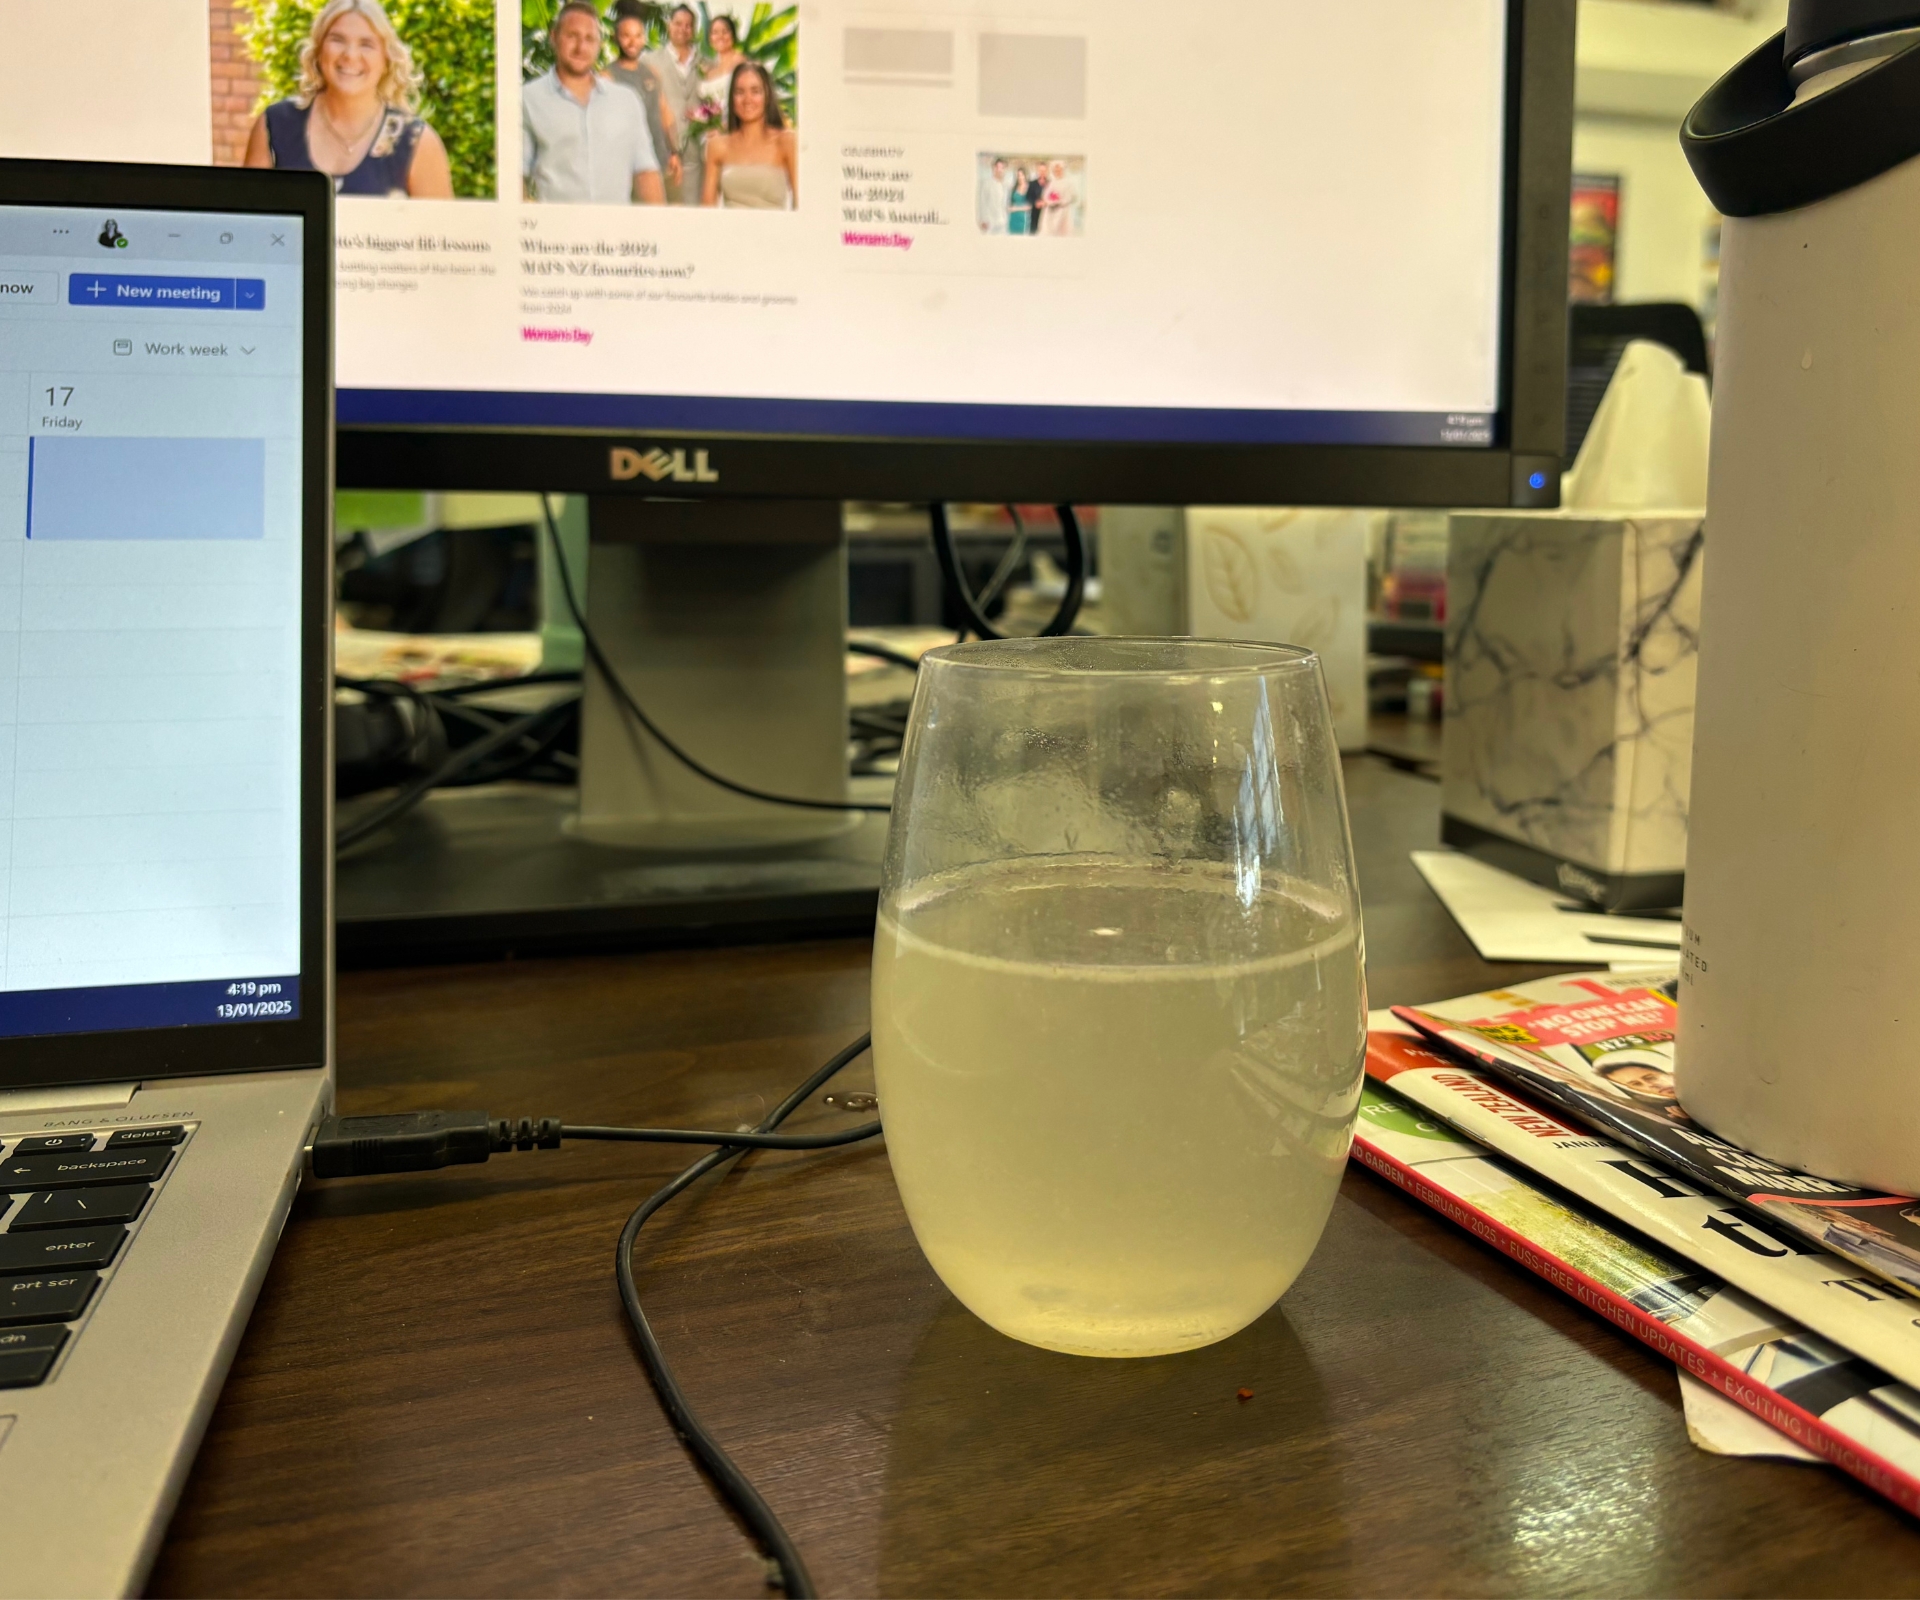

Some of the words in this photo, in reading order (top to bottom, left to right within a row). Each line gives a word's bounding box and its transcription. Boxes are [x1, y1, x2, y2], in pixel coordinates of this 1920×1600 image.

[0, 283, 34, 295] now
[117, 285, 152, 298] New
[157, 286, 221, 303] meeting
[145, 342, 184, 355] Work
[192, 344, 228, 356] week
[46, 386, 75, 407] 17
[42, 416, 82, 430] Friday
[609, 447, 718, 482] DELL
[226, 982, 255, 996] 4:19
[259, 982, 281, 997] pm
[216, 1000, 292, 1018] 13/01/2025
[1570, 1004, 1619, 1021] ONE
[1614, 997, 1665, 1013] CAN
[1560, 1017, 1617, 1038] STOP
[1430, 1073, 1525, 1115] ZEALAND
[44, 1119, 93, 1127] BANG
[116, 1111, 194, 1123] OLUFSEN
[1500, 1111, 1572, 1138] NEW
[121, 1129, 171, 1139] delete
[57, 1158, 147, 1171] backspace
[45, 1241, 95, 1251] enter
[12, 1281, 43, 1291] prt
[48, 1278, 78, 1287] scr
[1365, 1150, 1405, 1187] GARDEN
[1415, 1182, 1469, 1228] FEBRUARY
[1471, 1217, 1497, 1242] 2025
[1510, 1241, 1574, 1292] FUSS-FREE
[1577, 1283, 1635, 1331] KITCHEN
[1639, 1325, 1707, 1376] UPDATES
[1724, 1375, 1803, 1435] EXCITING
